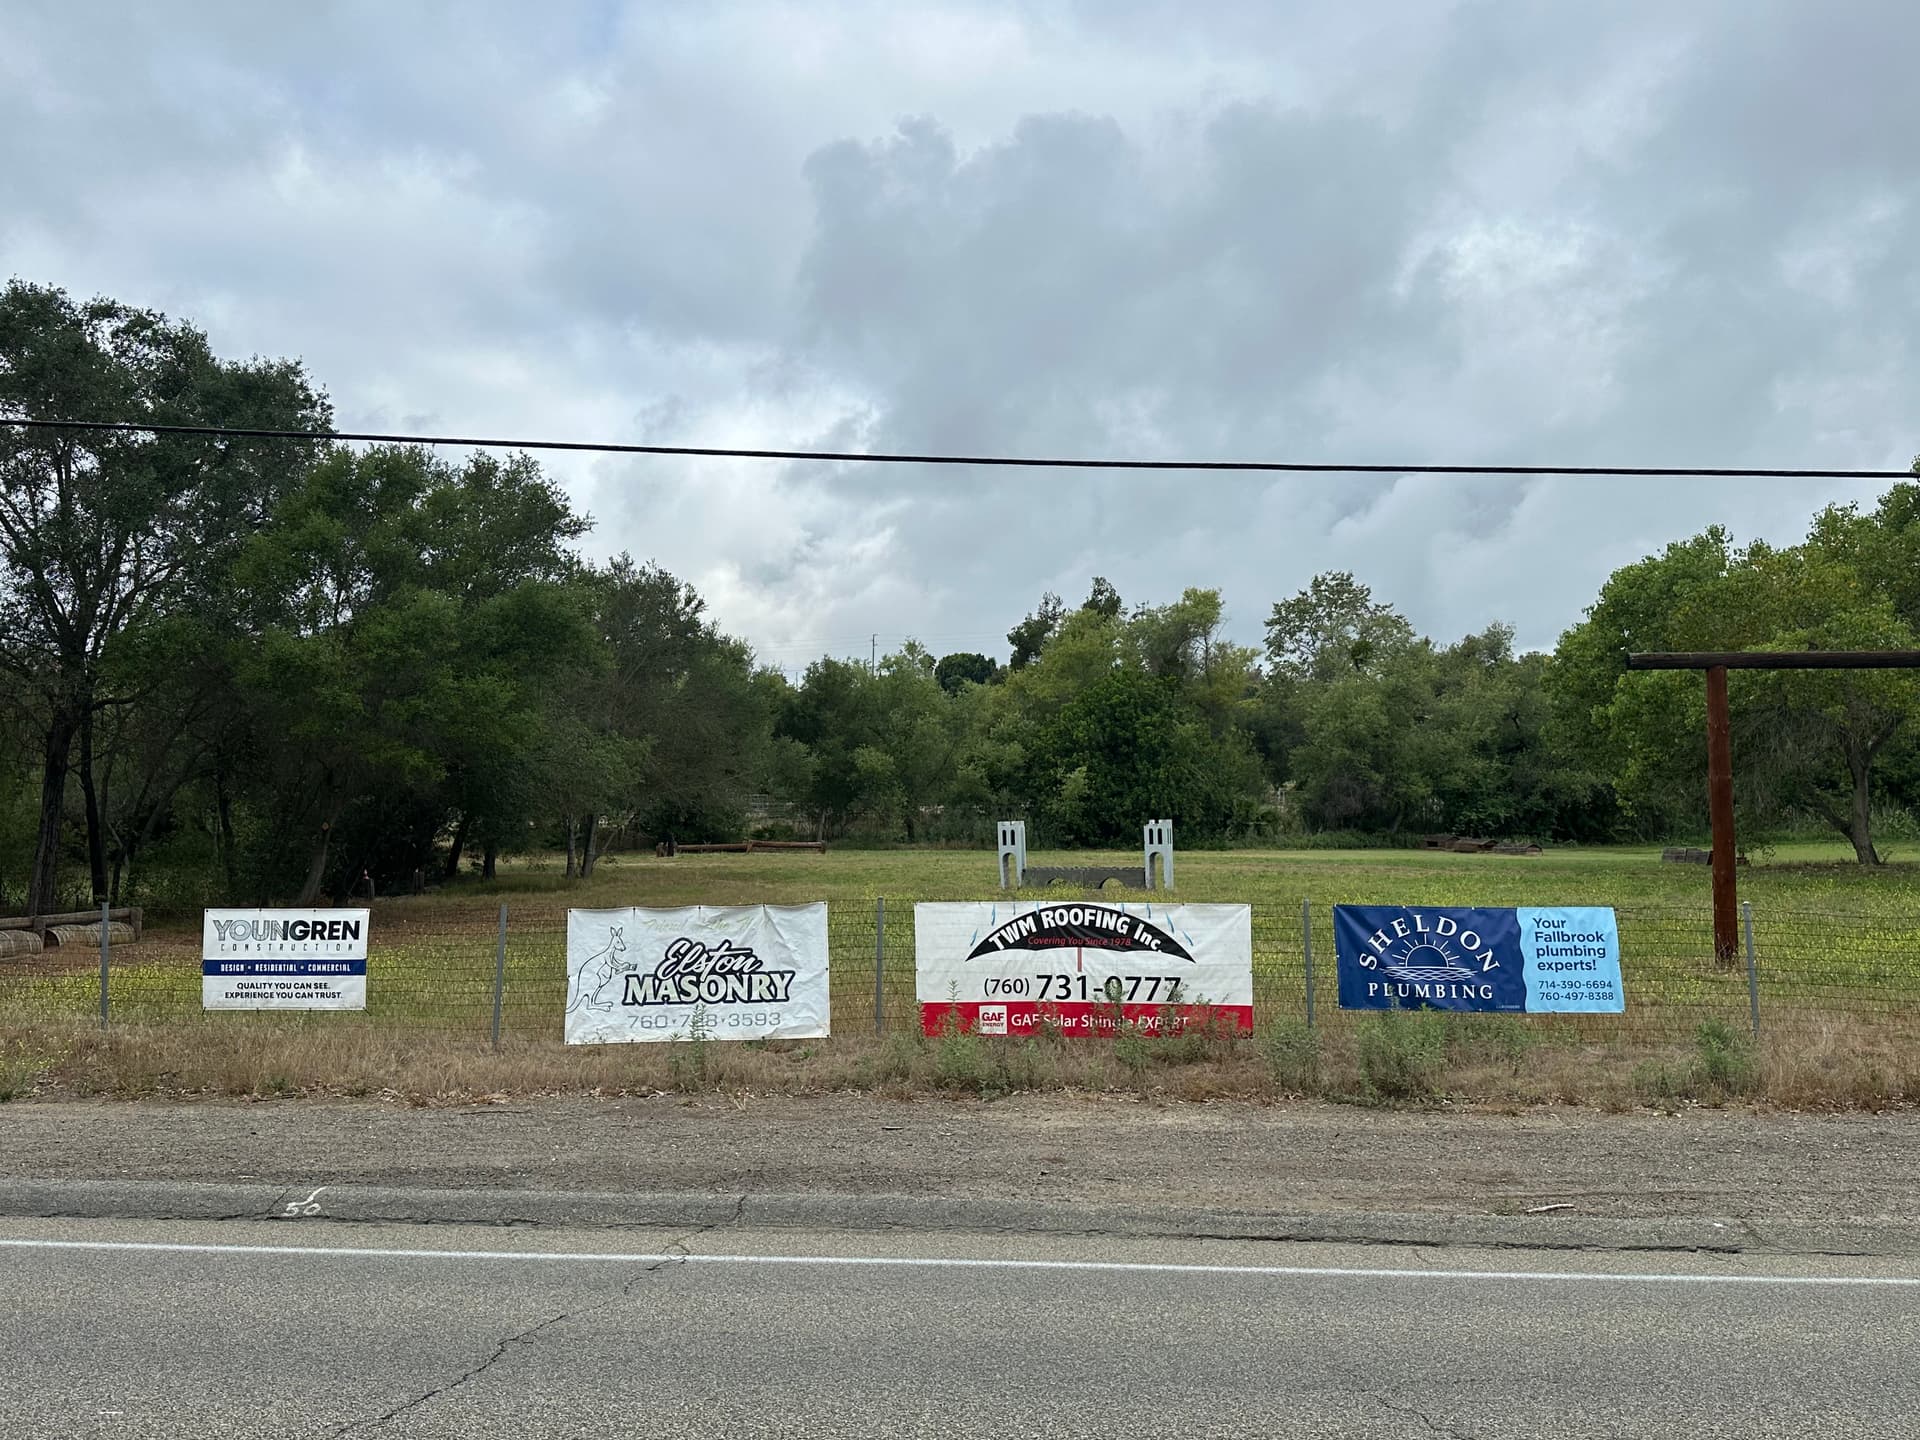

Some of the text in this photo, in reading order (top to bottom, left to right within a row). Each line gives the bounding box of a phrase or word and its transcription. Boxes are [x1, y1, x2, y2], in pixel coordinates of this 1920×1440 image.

[988, 916, 1037, 951] TWM
[1041, 908, 1130, 935] ROOFING
[1532, 917, 1566, 929] Your
[213, 920, 360, 941] YOUNGREN
[1535, 931, 1605, 943] Fallbrook
[220, 943, 353, 952] CONSTRUCTION
[1028, 937, 1132, 947] Covering You Since 1978
[1360, 915, 1500, 973] SHELDON
[1536, 945, 1606, 959] plumbing
[655, 938, 764, 982] Elston
[1537, 959, 1597, 973] experts!
[220, 963, 351, 972] DESIGN RESIDENTIAL COMMERCIAL
[237, 982, 331, 990] QUALITY YOU CAN SEE.
[622, 970, 795, 1006] MASONRY
[984, 974, 1182, 1001] (760) 731-0777
[1368, 982, 1493, 999] PLUMBING
[1538, 980, 1613, 989] 714-390-6694
[1539, 991, 1614, 1001] 760-497-8388
[982, 1012, 1005, 1021] GAF
